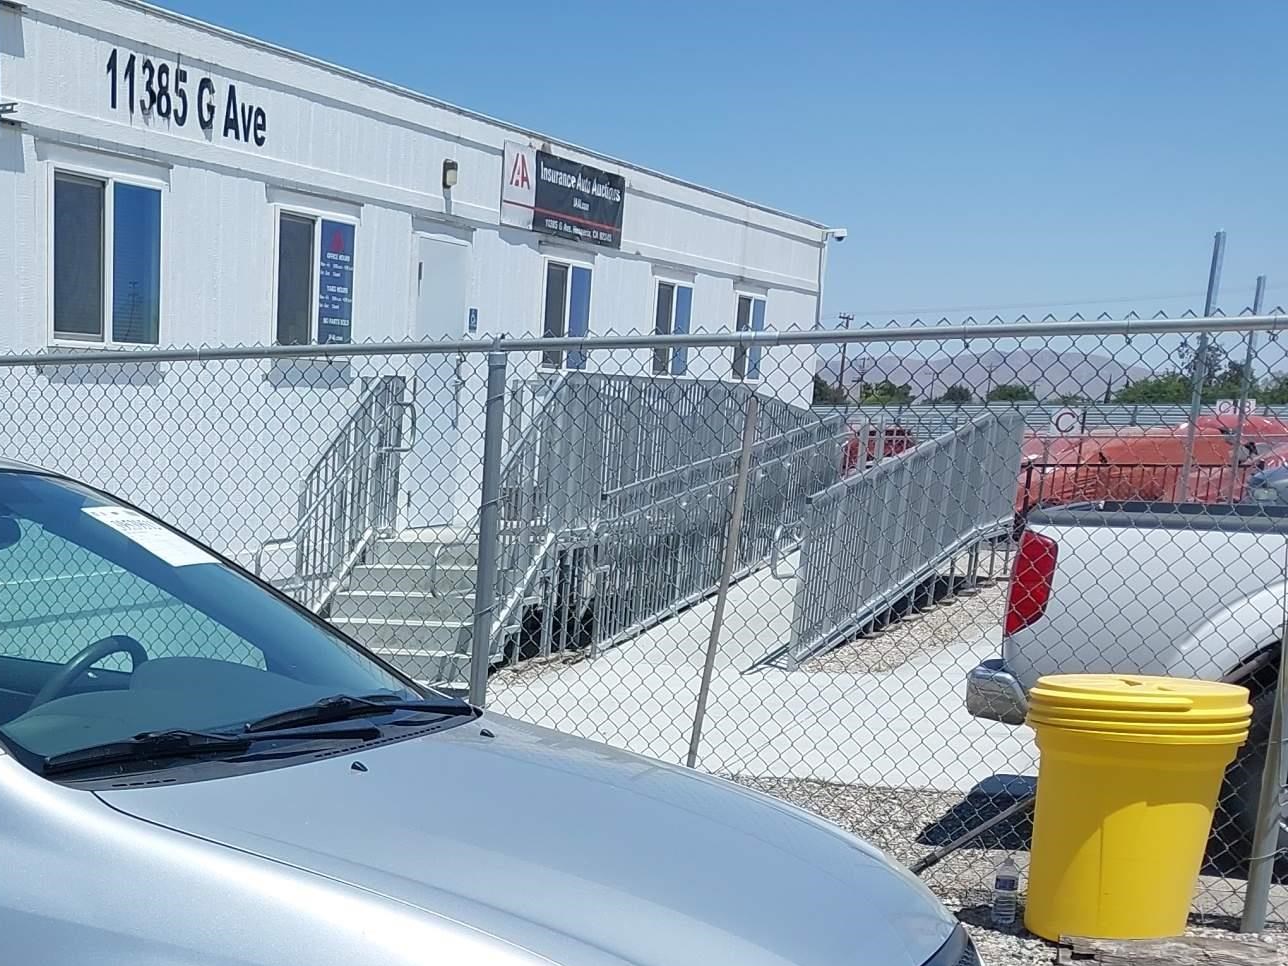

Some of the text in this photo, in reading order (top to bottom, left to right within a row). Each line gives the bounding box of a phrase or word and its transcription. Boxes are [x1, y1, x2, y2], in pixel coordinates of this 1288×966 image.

[107, 49, 266, 147] 11385 G Ave
[540, 161, 621, 202] Insurance Auto Auctions
